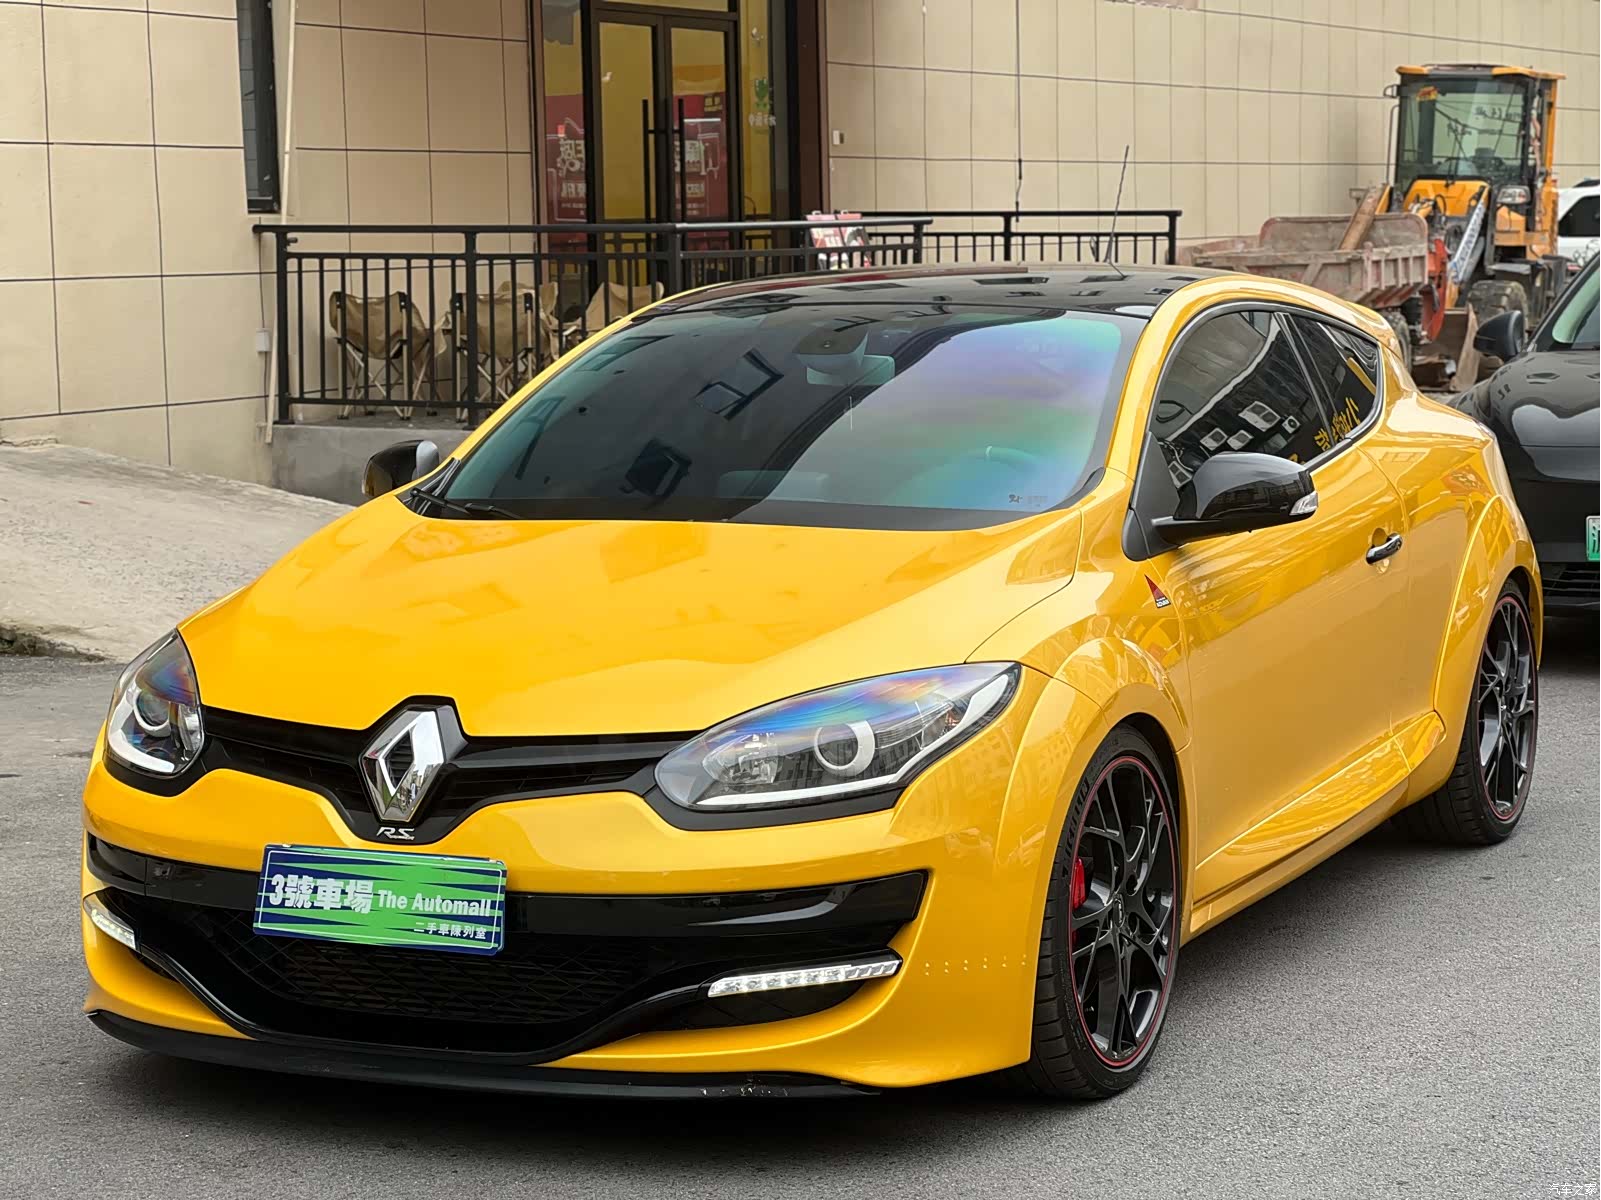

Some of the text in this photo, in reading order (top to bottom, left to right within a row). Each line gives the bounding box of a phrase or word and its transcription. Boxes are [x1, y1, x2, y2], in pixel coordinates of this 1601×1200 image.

[269, 873, 491, 917] 3號車場 The Automall
[414, 922, 487, 940] 二手車陳列室
